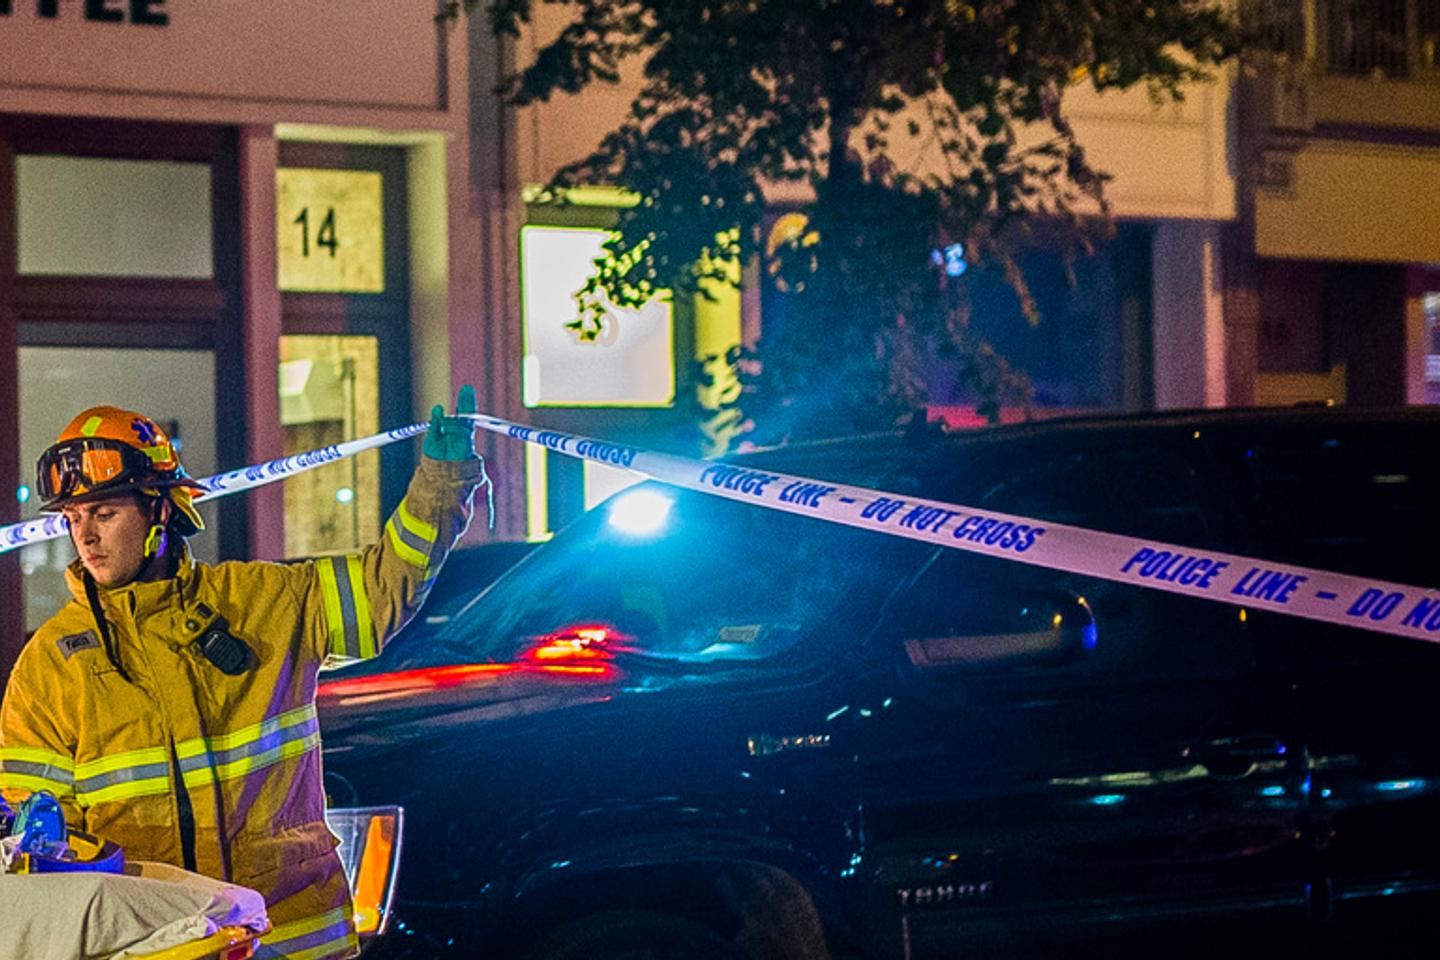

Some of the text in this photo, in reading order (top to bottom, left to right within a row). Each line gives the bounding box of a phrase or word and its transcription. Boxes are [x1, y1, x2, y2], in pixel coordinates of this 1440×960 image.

[293, 207, 338, 258] 14
[699, 464, 778, 497] POLICE
[779, 480, 836, 508] LINE
[860, 496, 905, 523] DO
[899, 504, 960, 535] NOT
[954, 515, 1047, 553] CROSS
[1120, 547, 1231, 589] POLICE
[1230, 567, 1309, 604] LINE
[1346, 588, 1406, 622] DO
